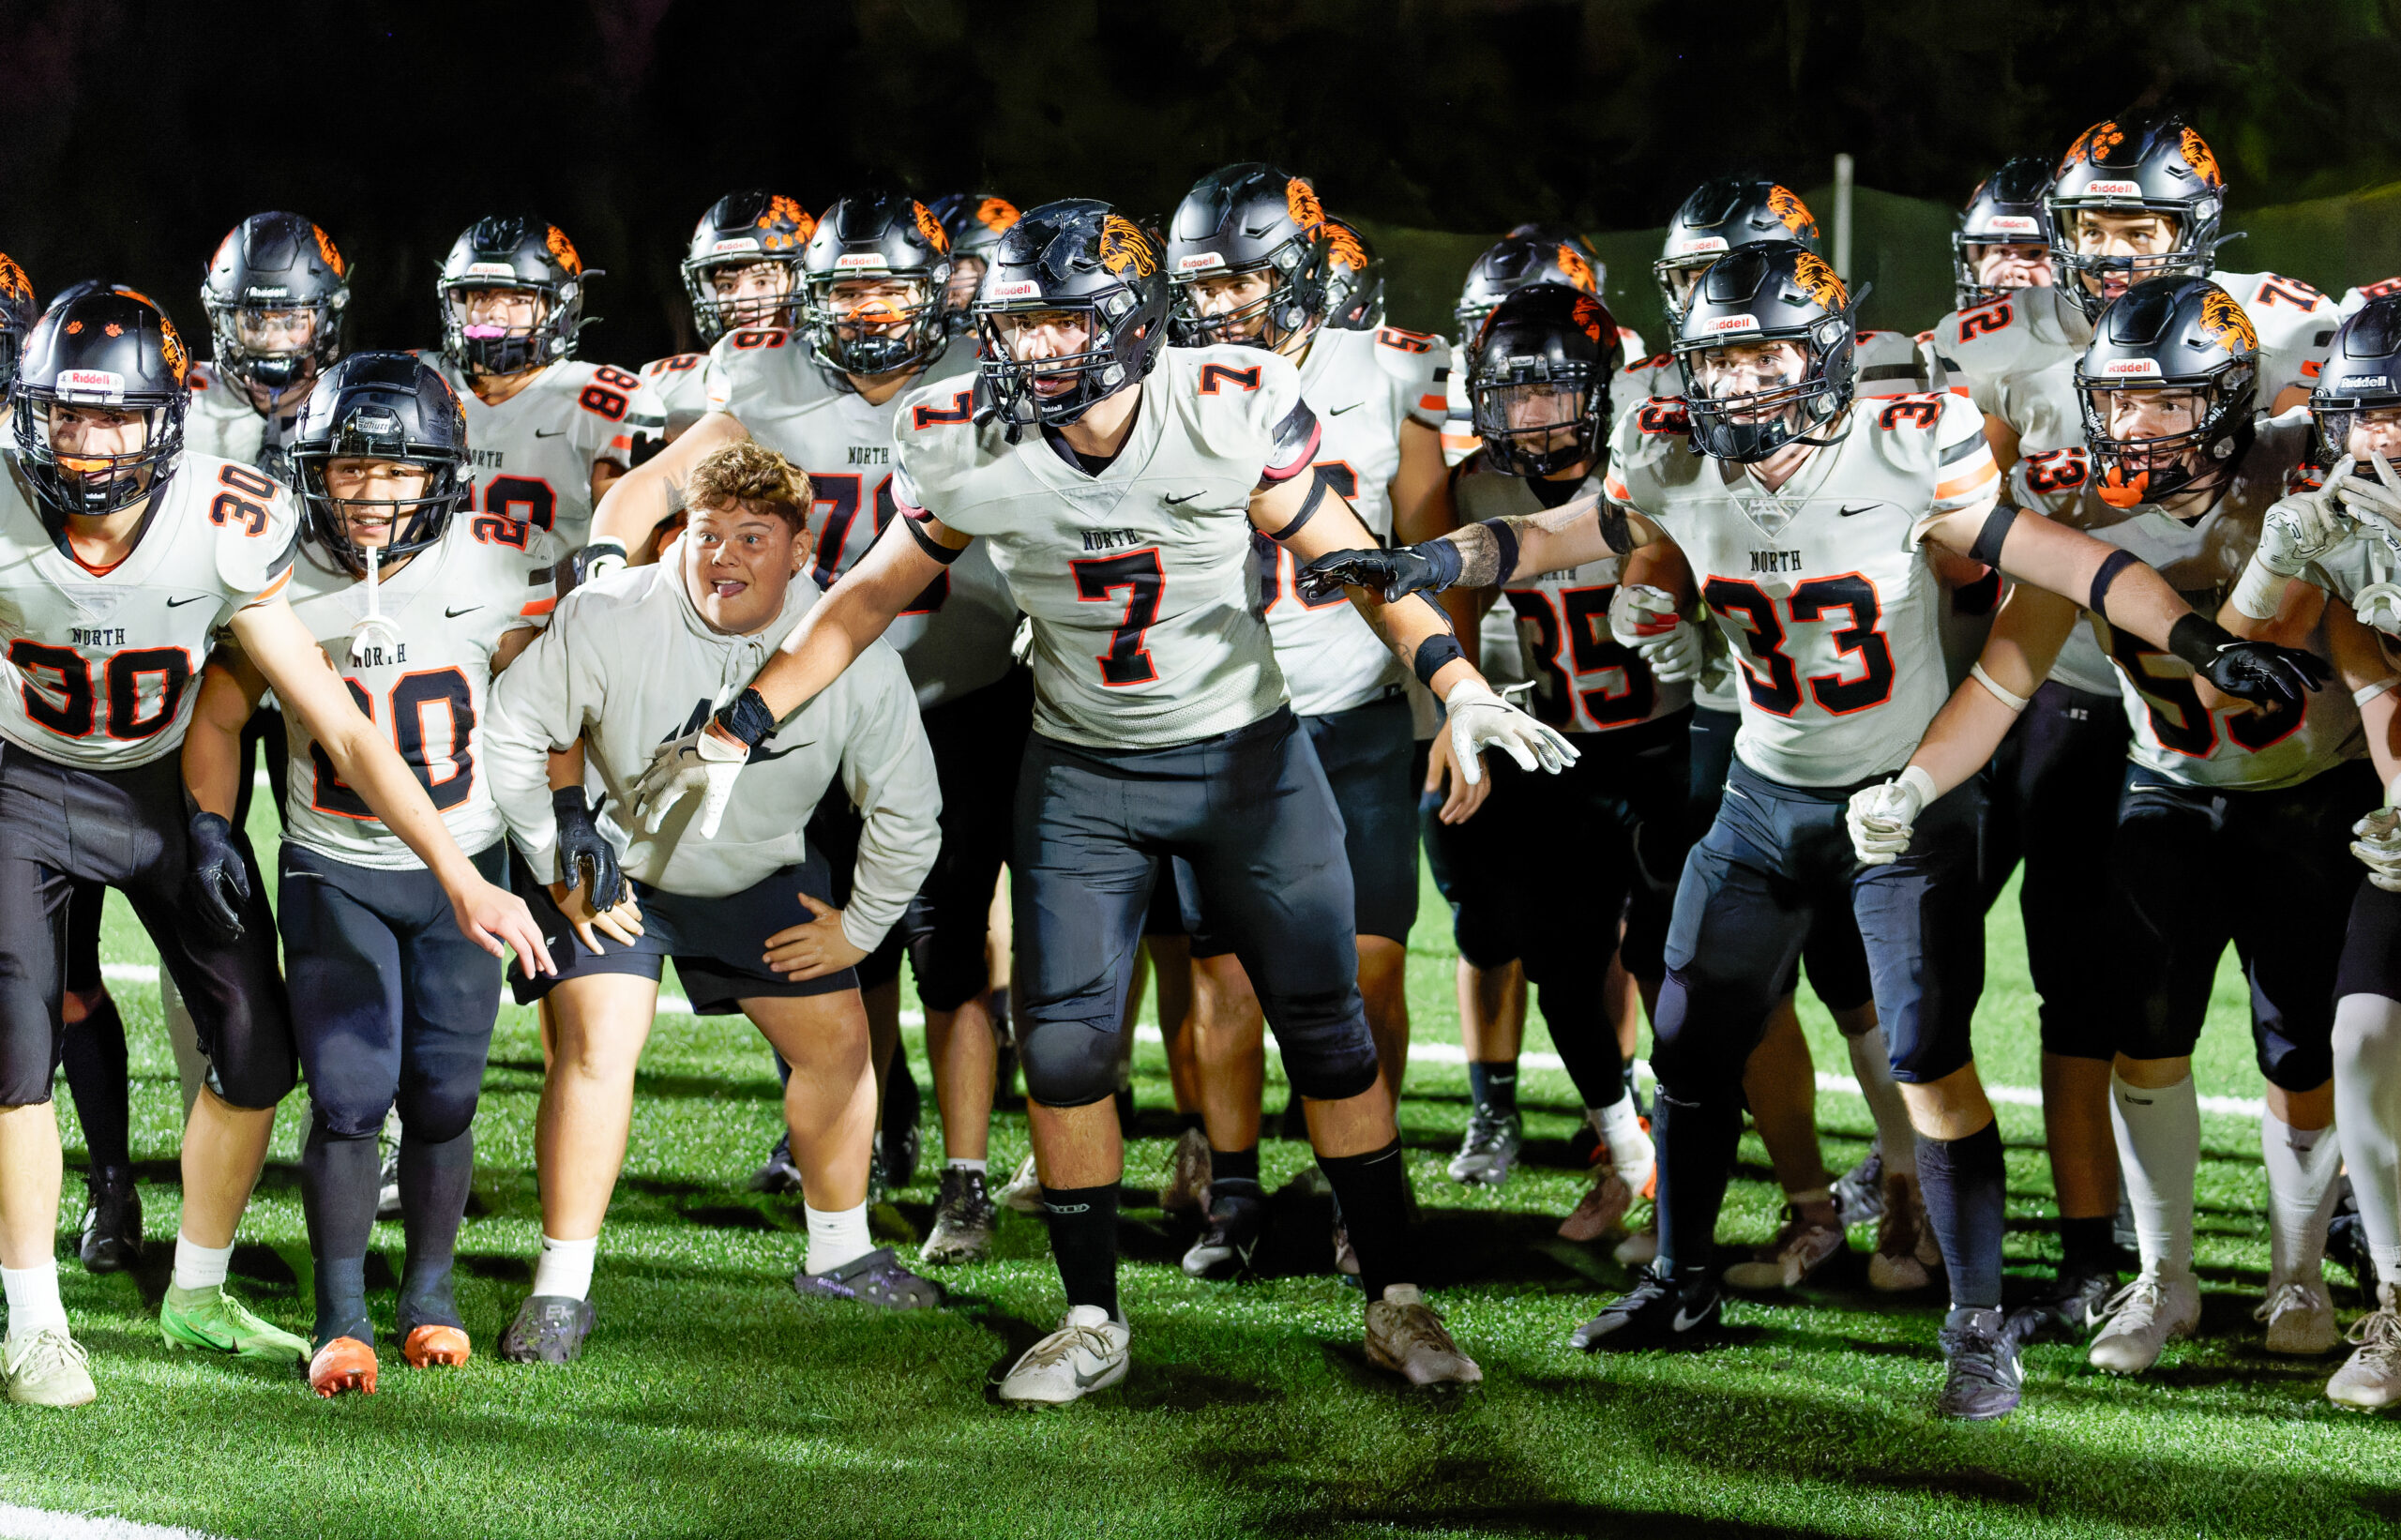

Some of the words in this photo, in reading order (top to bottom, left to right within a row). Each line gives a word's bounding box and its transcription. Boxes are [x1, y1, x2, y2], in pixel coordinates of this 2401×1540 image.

[2090, 184, 2133, 193] Riddell
[840, 256, 880, 266] Riddell
[1182, 255, 1216, 268] Riddell
[994, 284, 1032, 296] Riddell
[1707, 318, 1750, 331] Riddell
[71, 372, 111, 385] Riddell
[1198, 363, 1262, 396] 7
[578, 365, 643, 423] 88
[913, 389, 974, 431] 7
[471, 449, 505, 469] ORTH
[848, 446, 890, 465] NORTH
[208, 464, 280, 539] 30
[470, 511, 531, 553] 2
[1081, 528, 1140, 551] NORTH
[1749, 550, 1803, 573] NORTH
[1067, 547, 1167, 687] 7
[71, 627, 127, 646] NORTH
[1699, 570, 1896, 718] 33
[1503, 583, 1656, 731] 35
[8, 638, 194, 743] 30
